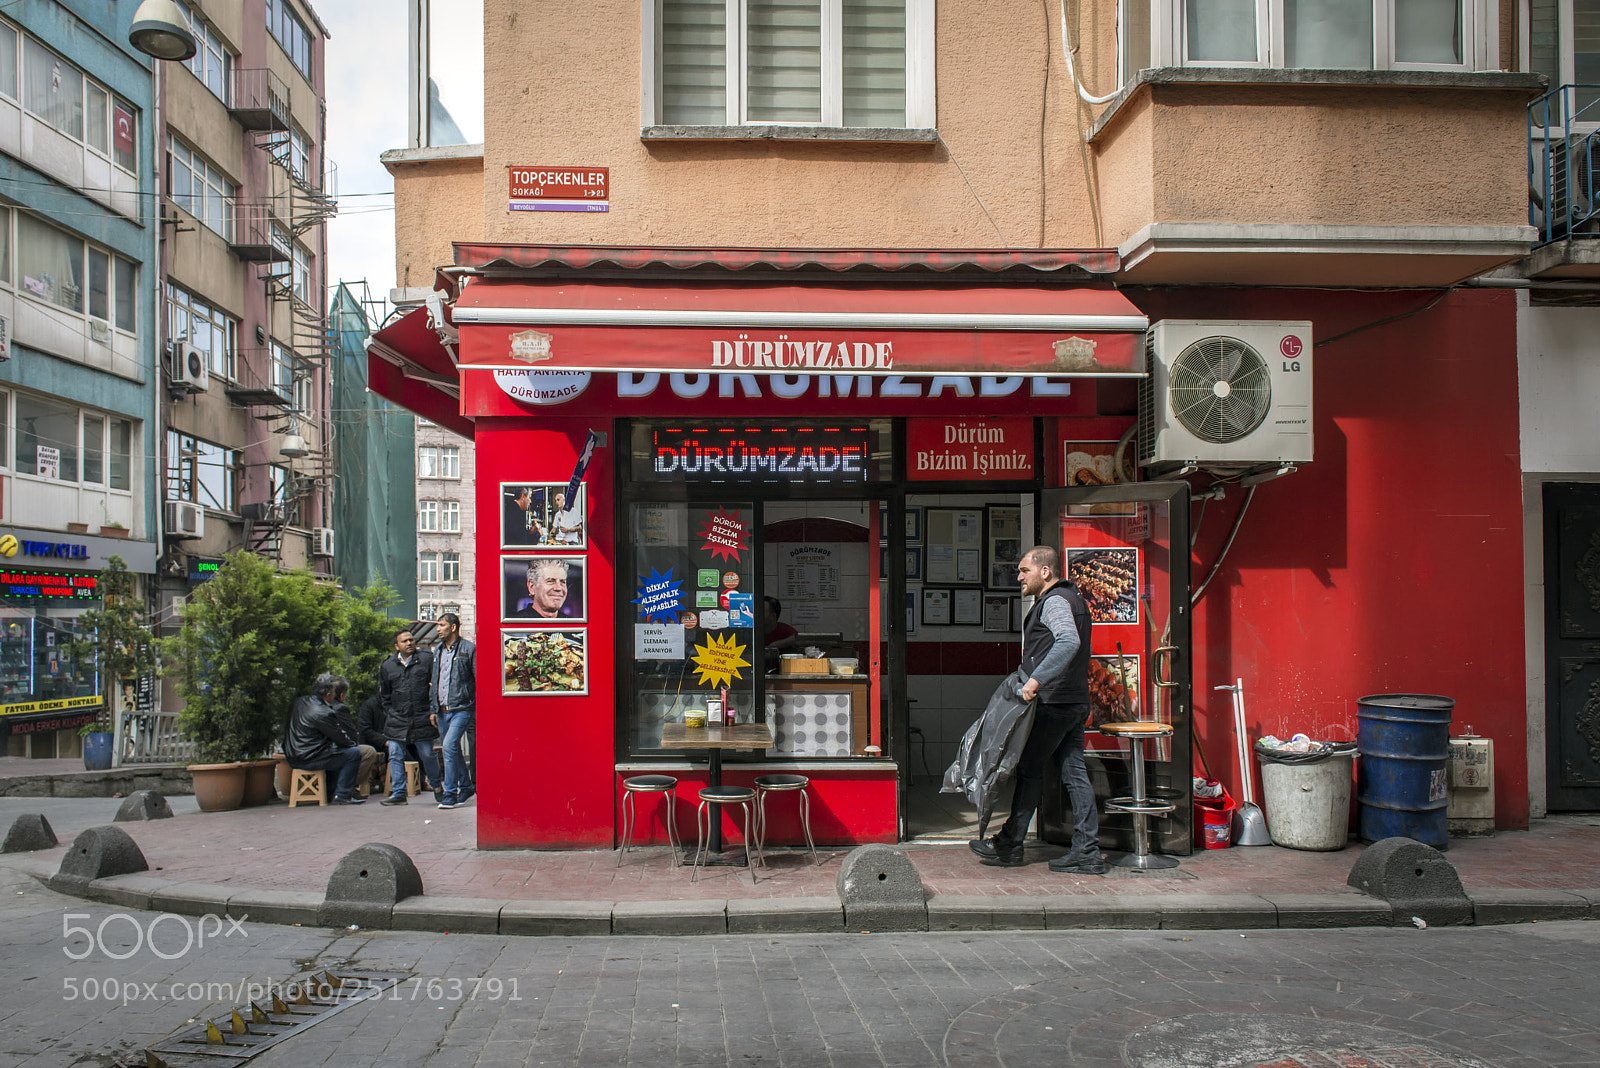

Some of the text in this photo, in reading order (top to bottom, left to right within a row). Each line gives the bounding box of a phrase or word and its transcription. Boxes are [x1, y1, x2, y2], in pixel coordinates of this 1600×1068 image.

[513, 171, 604, 187] TOPÇEKENLER
[512, 187, 544, 196] SOKAĞI
[711, 334, 893, 369] DÜRÜMZADE
[1282, 362, 1301, 372] LG
[510, 384, 579, 399] DÜRÜMZADE
[944, 423, 1005, 444] Dürüm
[656, 440, 861, 473] DÜRÜMZADE
[917, 446, 1032, 476] Bizim İşimiz.
[713, 516, 742, 530] DÜRÜM
[712, 525, 738, 539] BİZİM
[707, 533, 739, 549] İŞİMİZ
[1, 572, 25, 584] DİLARA
[25, 574, 69, 587] GAYRİMENKUL
[646, 580, 670, 593] DİKKAT
[9, 586, 92, 597] TURKCELL VODAFONE AVEA
[641, 588, 679, 605] ALIŞKANLIK
[645, 599, 679, 614] YAPABİLİR
[643, 628, 663, 636] SERVİS
[5, 697, 97, 714] FATURA ÖDEME NOKTASI
